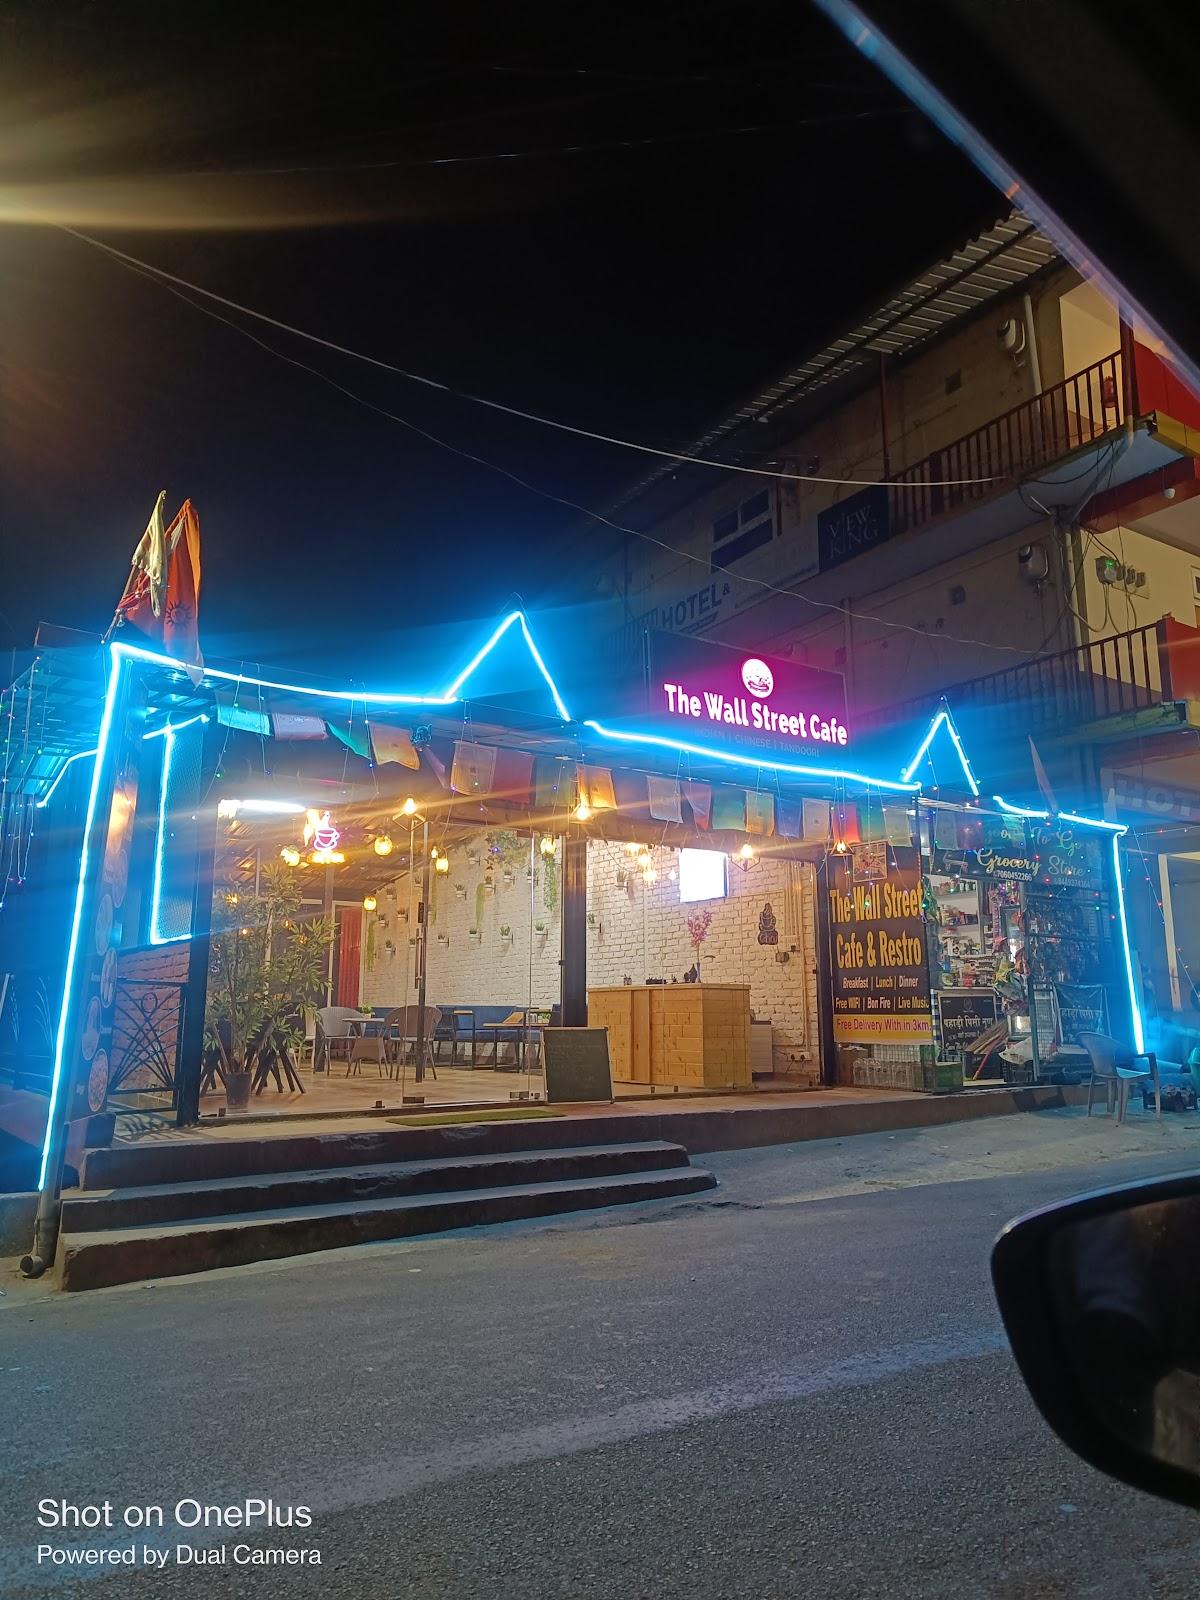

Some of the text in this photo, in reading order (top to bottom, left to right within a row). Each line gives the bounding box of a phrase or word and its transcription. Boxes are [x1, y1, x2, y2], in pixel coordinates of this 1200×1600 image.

[662, 582, 722, 629] HOTEL
[663, 683, 848, 746] The Wall Street Cafe
[735, 734, 771, 749] CHINESE
[974, 847, 1086, 877] Grocery Store
[830, 880, 924, 923] The Wall Street
[836, 929, 922, 969] Cafe & Restro
[843, 975, 919, 989] Breakfast Lunch Dinner
[835, 997, 848, 1008] Free
[867, 997, 878, 1008] Bon
[879, 997, 891, 1008] Fire
[898, 996, 911, 1008] Live
[836, 1018, 853, 1030] Free
[853, 1018, 883, 1032] Delivery
